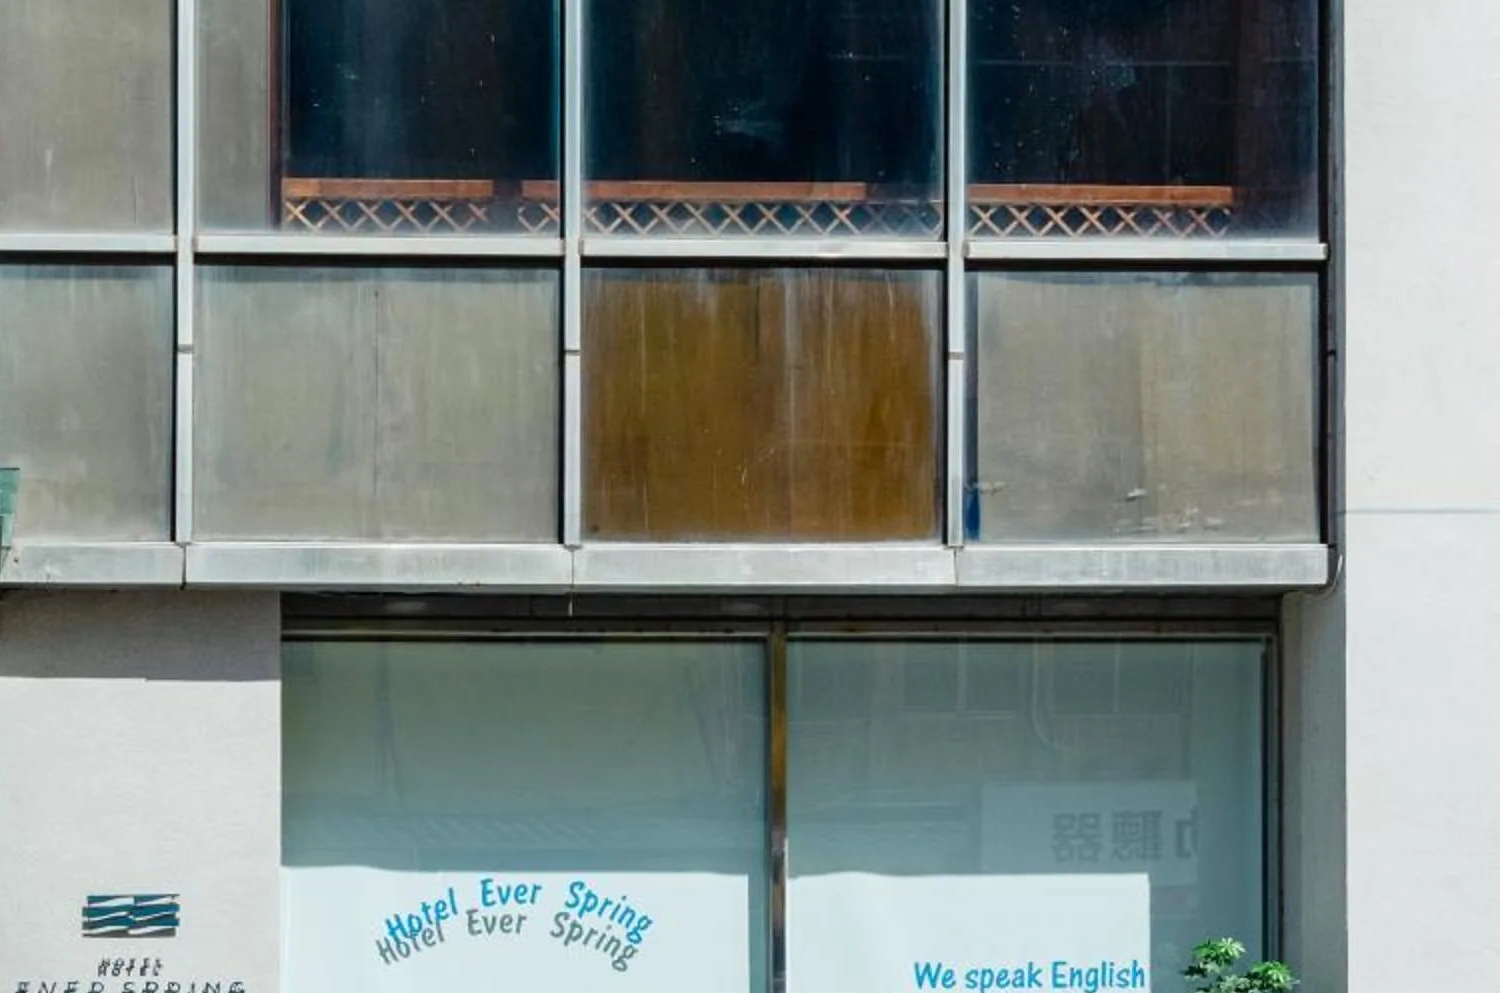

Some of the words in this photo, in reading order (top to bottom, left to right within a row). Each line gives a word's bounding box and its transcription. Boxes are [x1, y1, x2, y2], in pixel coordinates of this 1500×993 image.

[385, 886, 458, 939] Hotel
[480, 878, 542, 907] Ever
[564, 880, 653, 945] Spring
[914, 962, 957, 990] We
[1051, 960, 1146, 993] English
